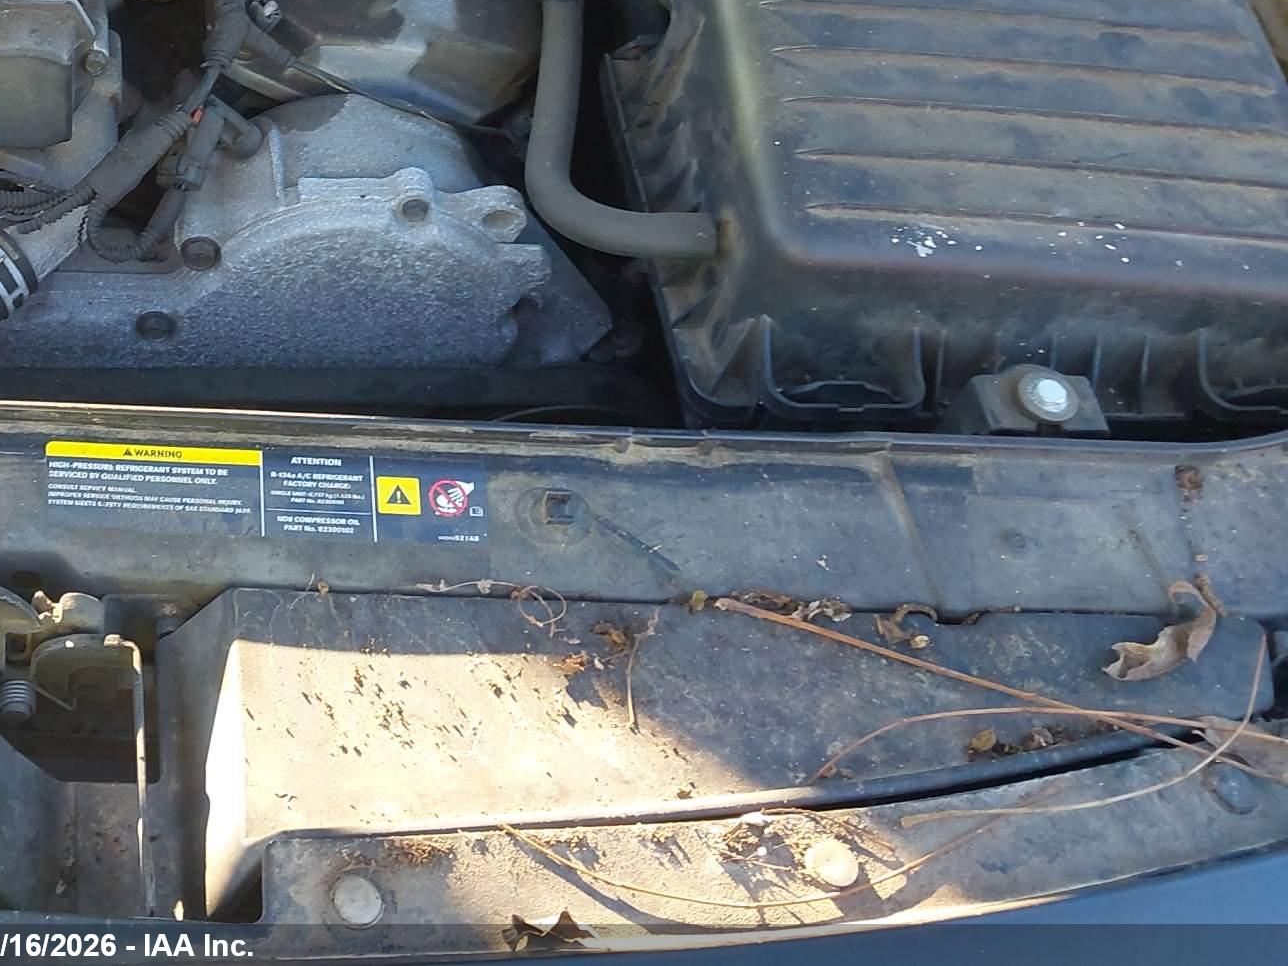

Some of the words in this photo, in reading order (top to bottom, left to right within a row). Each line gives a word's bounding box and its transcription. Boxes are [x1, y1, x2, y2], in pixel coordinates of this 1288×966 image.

[134, 448, 183, 459] WARNING
[290, 456, 343, 467] ATTENTION
[48, 461, 114, 471] HIGH-PRESSURE
[115, 464, 171, 474] REFRIGERANT
[171, 466, 204, 475] SYSTEM
[205, 468, 217, 476] TO
[217, 468, 229, 476] BE
[48, 470, 88, 479] SERVICED
[88, 472, 101, 480] BY
[101, 472, 144, 482] QUALIFIED
[145, 475, 193, 484] PERSONNEL
[194, 477, 218, 485] ONLY.
[270, 471, 297, 479] R-134a
[296, 472, 312, 480] A/C
[312, 474, 364, 482] REFRIGERANT
[283, 480, 318, 488] FACTORY
[122, 502, 173, 510] REQUIREMENTS
[182, 497, 217, 505] PERSONAL
[294, 516, 347, 525] COMPRESSOR
[347, 518, 361, 526] OIL
[283, 524, 303, 532] PART
